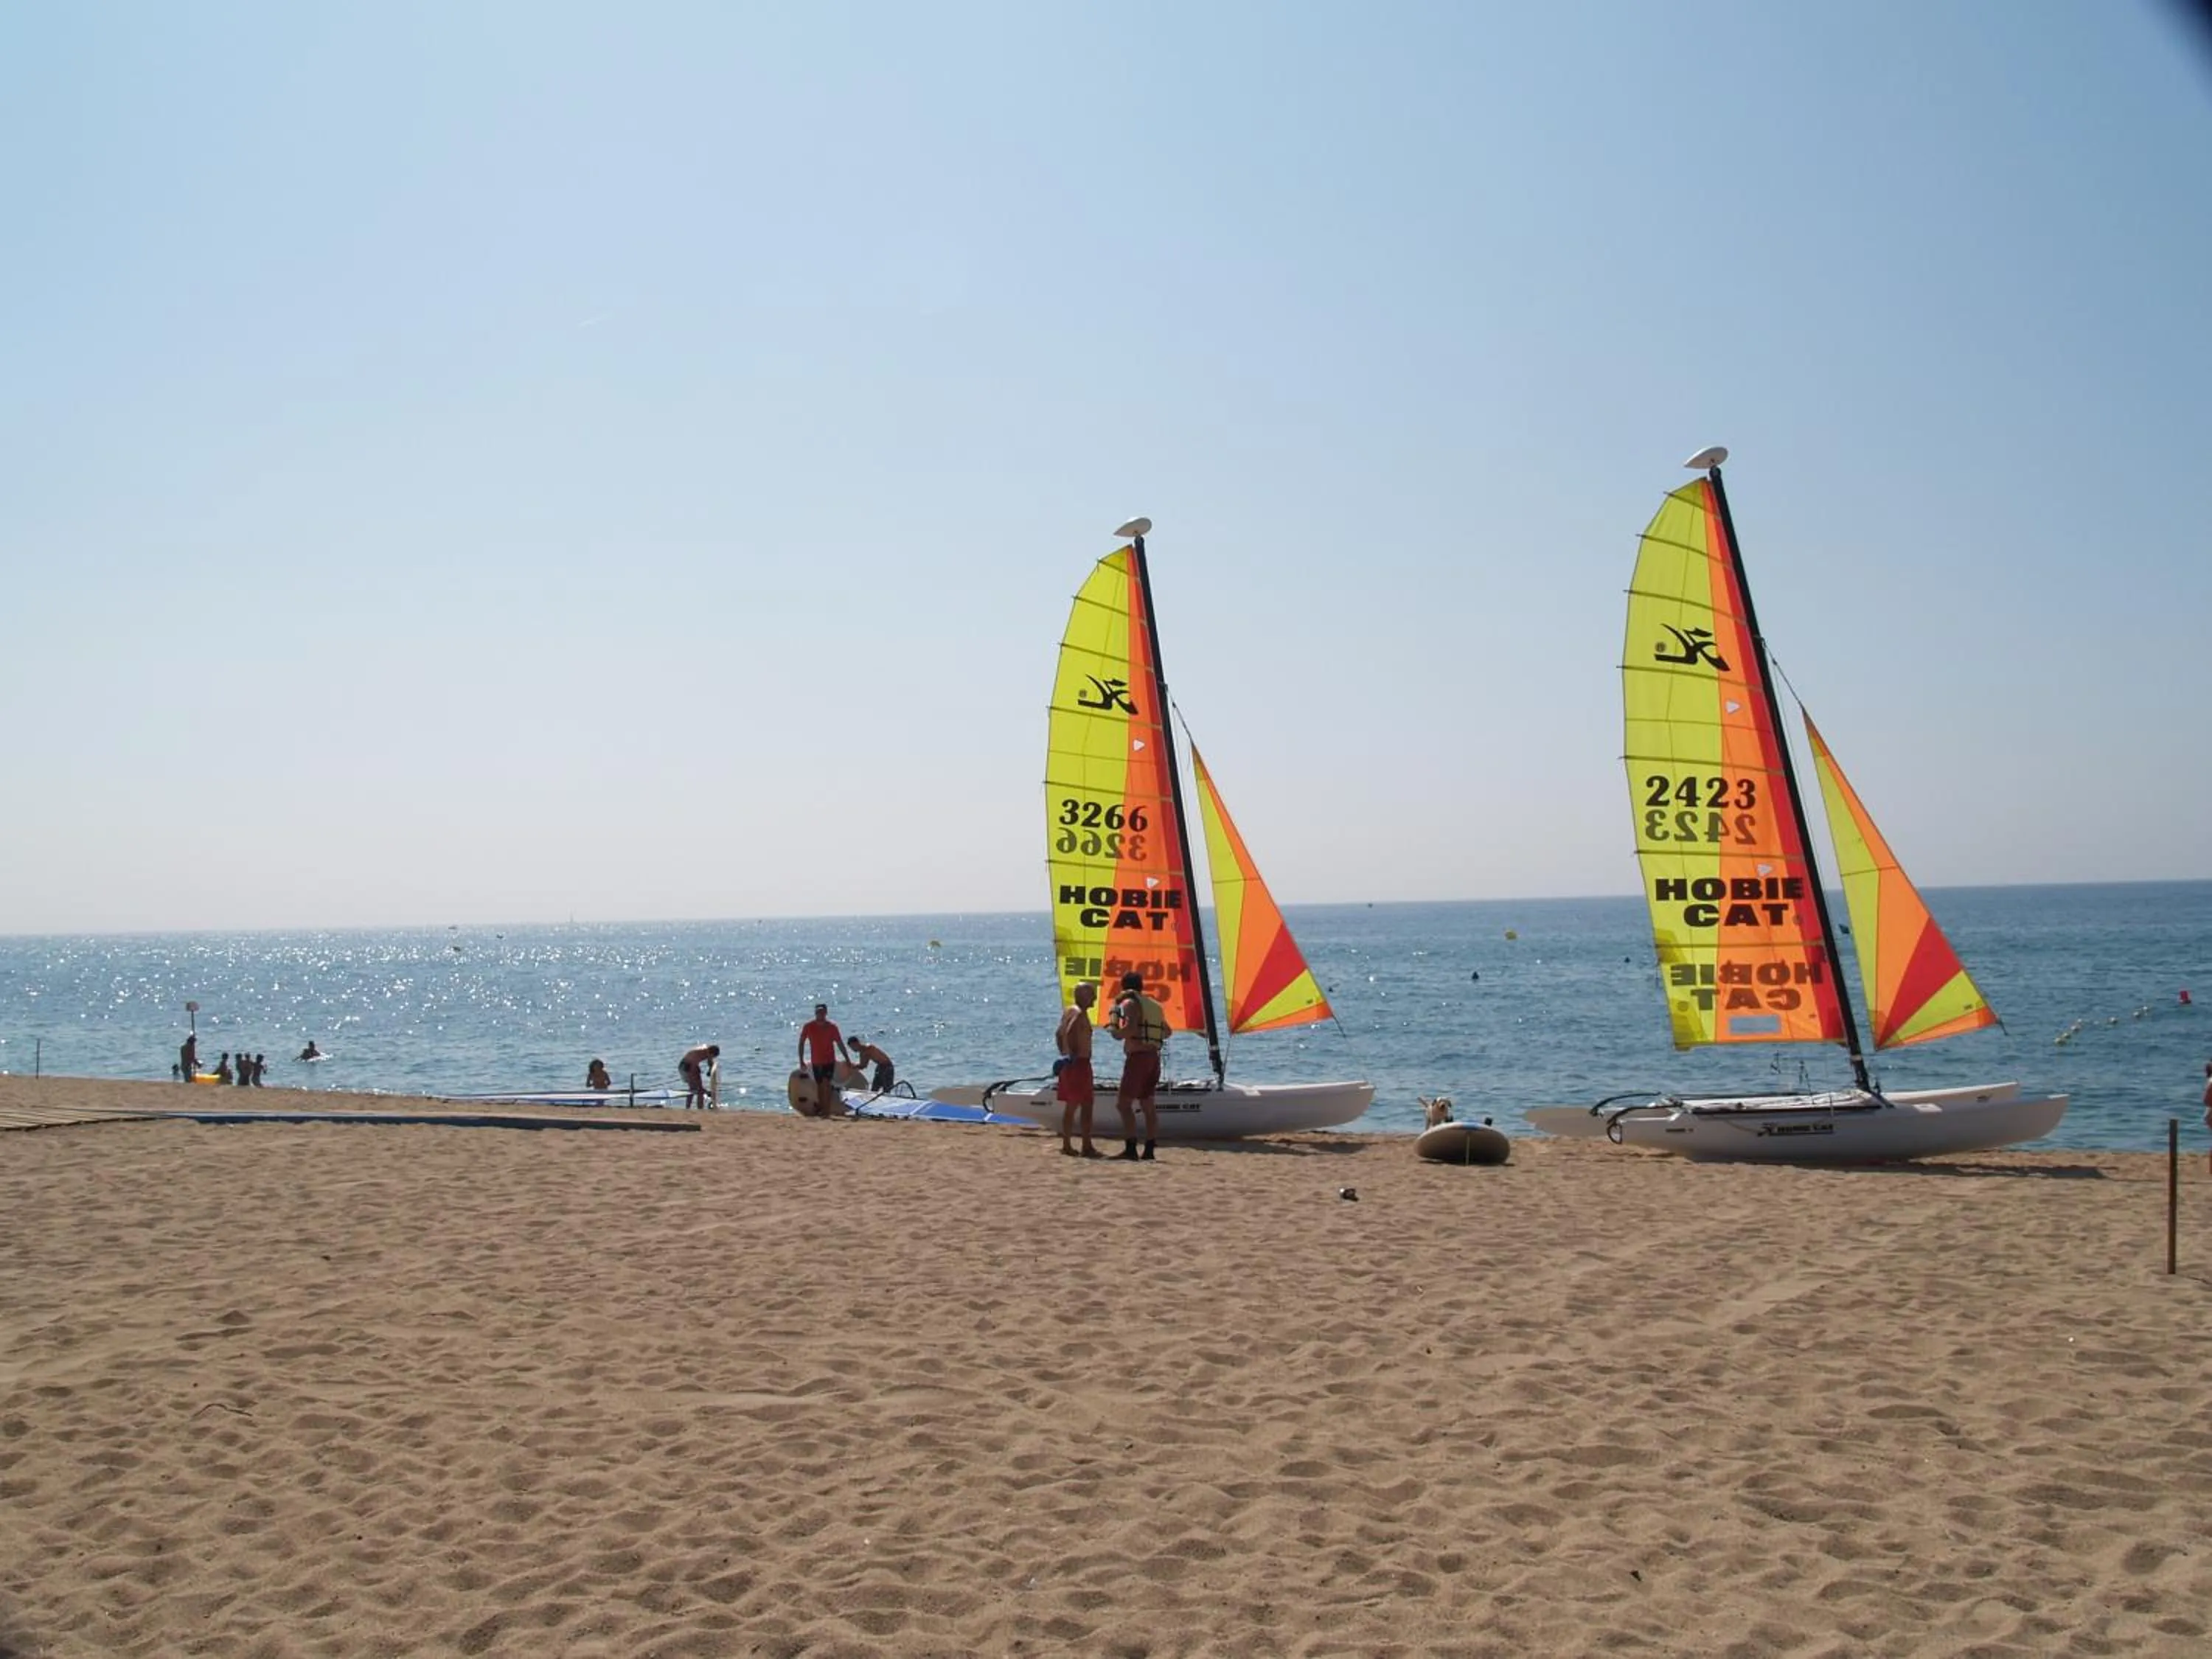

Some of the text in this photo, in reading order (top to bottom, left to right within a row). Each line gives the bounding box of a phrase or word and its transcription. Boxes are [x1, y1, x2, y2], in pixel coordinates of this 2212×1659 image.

[1645, 776, 1756, 810] 2423
[1059, 799, 1148, 832] 3266
[1060, 886, 1183, 909] HOBIE
[1655, 877, 1804, 901] HOBIE
[1079, 908, 1169, 931] CAT
[1683, 903, 1789, 928] CAT
